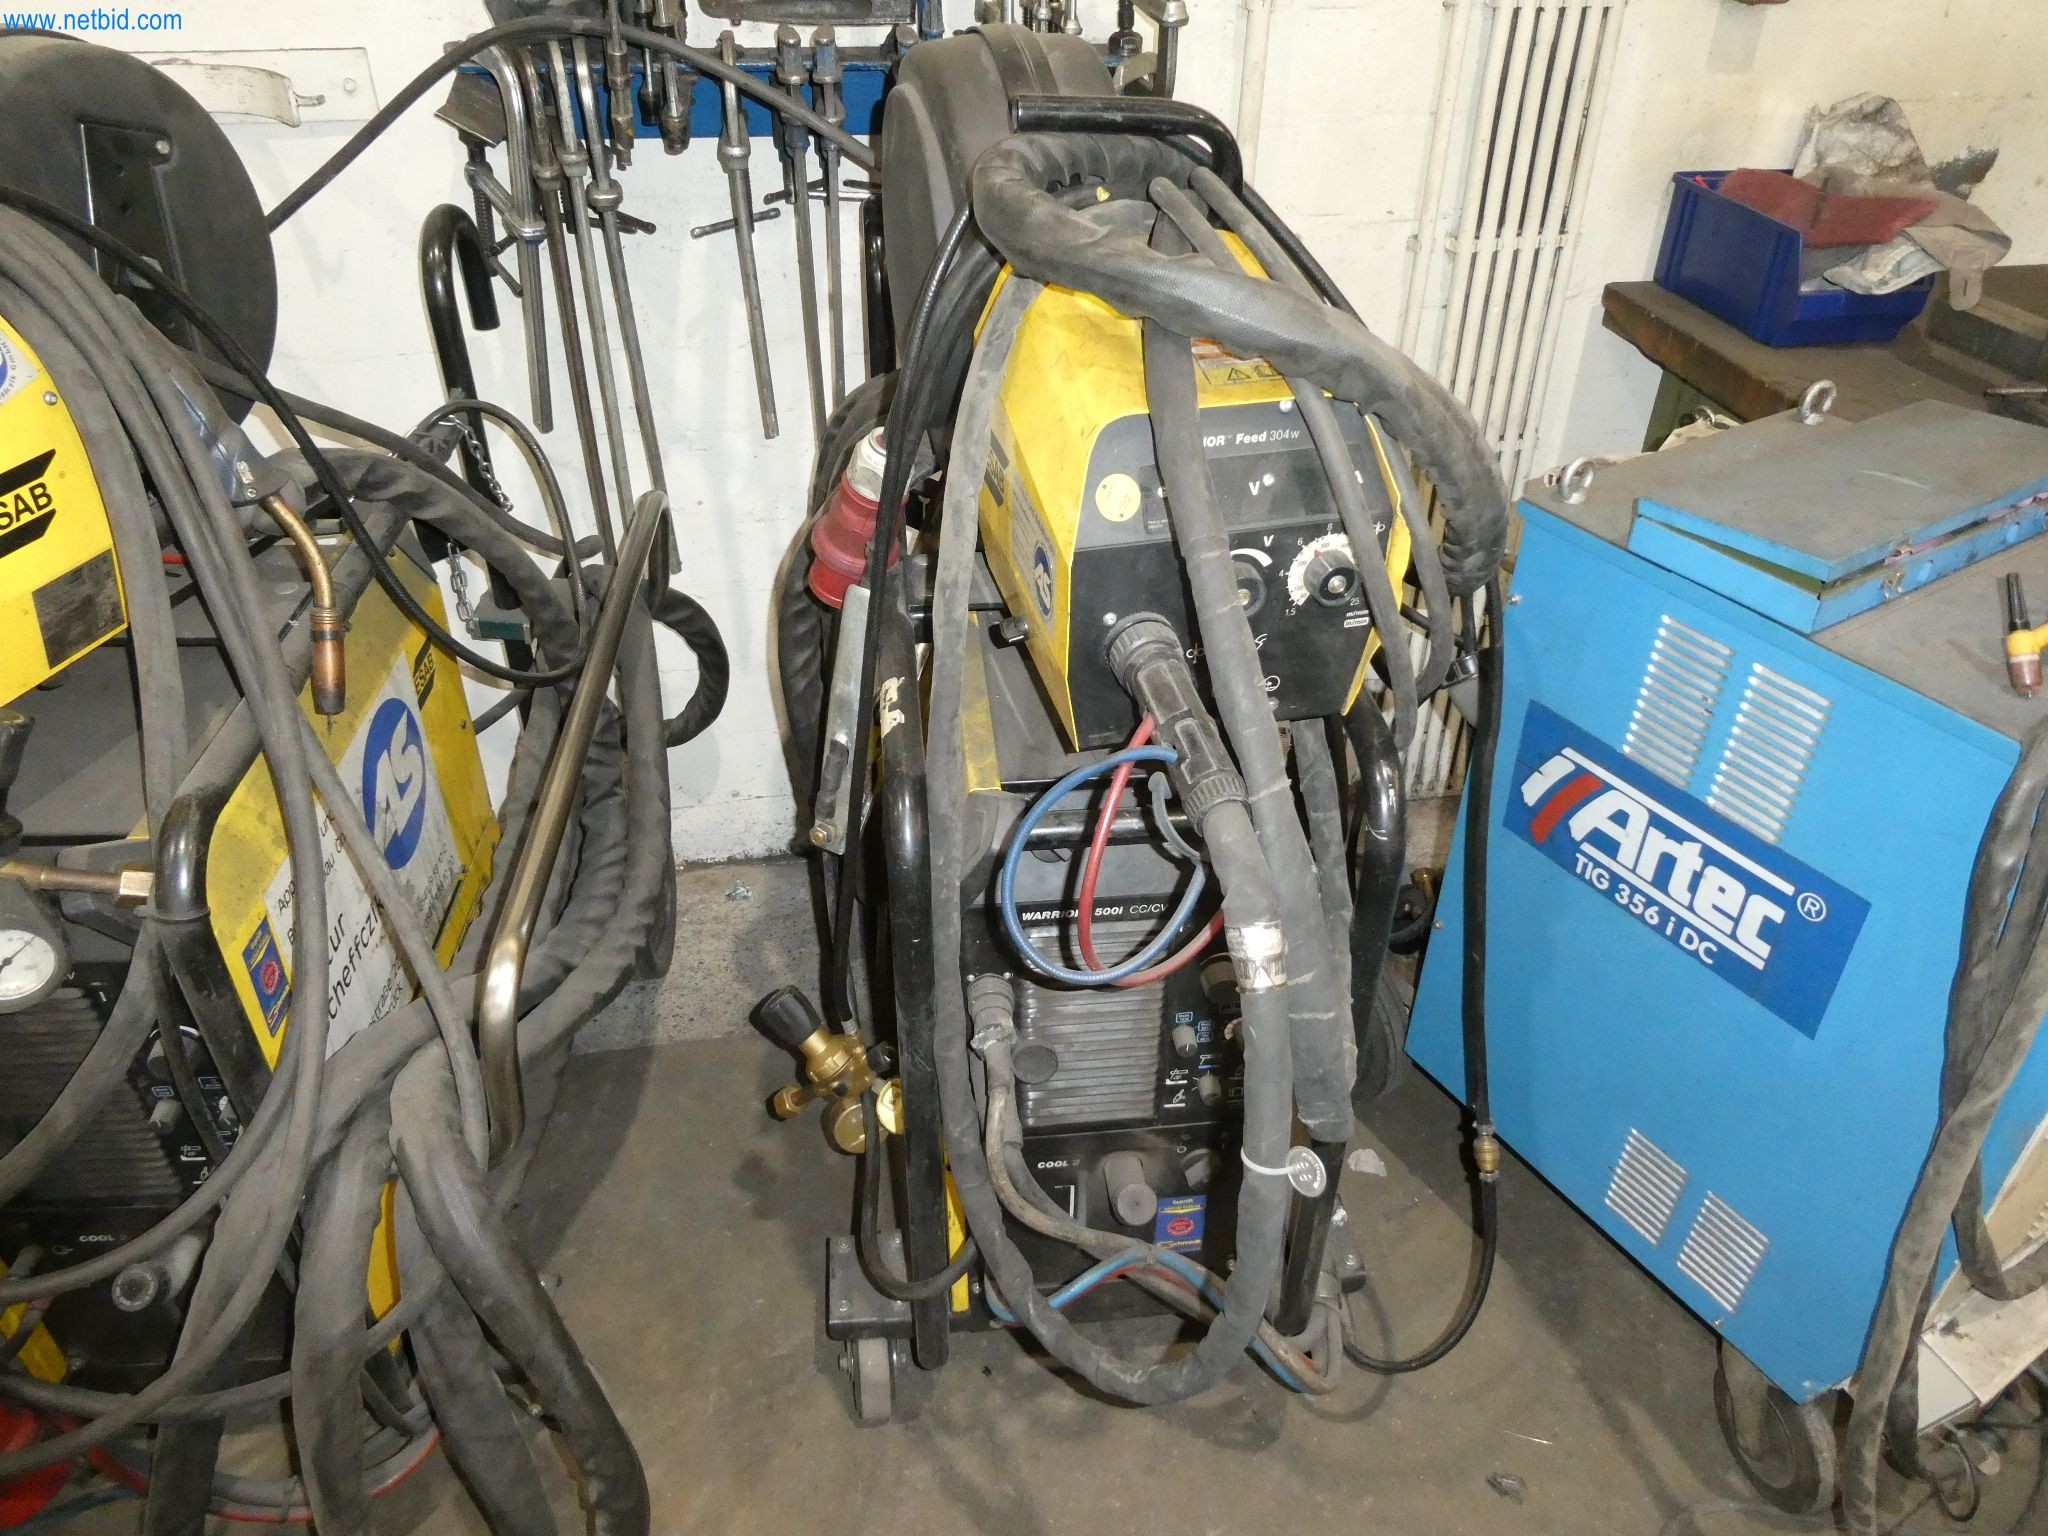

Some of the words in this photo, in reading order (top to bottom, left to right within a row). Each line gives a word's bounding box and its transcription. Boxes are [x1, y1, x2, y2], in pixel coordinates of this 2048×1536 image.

[1203, 436, 1226, 447] IOR
[1236, 431, 1267, 444] Feed
[0, 482, 53, 530] SAB
[1568, 789, 1786, 960] Artec
[1095, 906, 1124, 916] 500i
[1129, 903, 1168, 914] CC/CV
[1575, 852, 1610, 890] TIG
[1614, 883, 1660, 926] 356
[1665, 916, 1676, 936] i
[1679, 926, 1718, 965] DC
[1037, 1161, 1068, 1169] COOL
[79, 1234, 115, 1243] COOL
